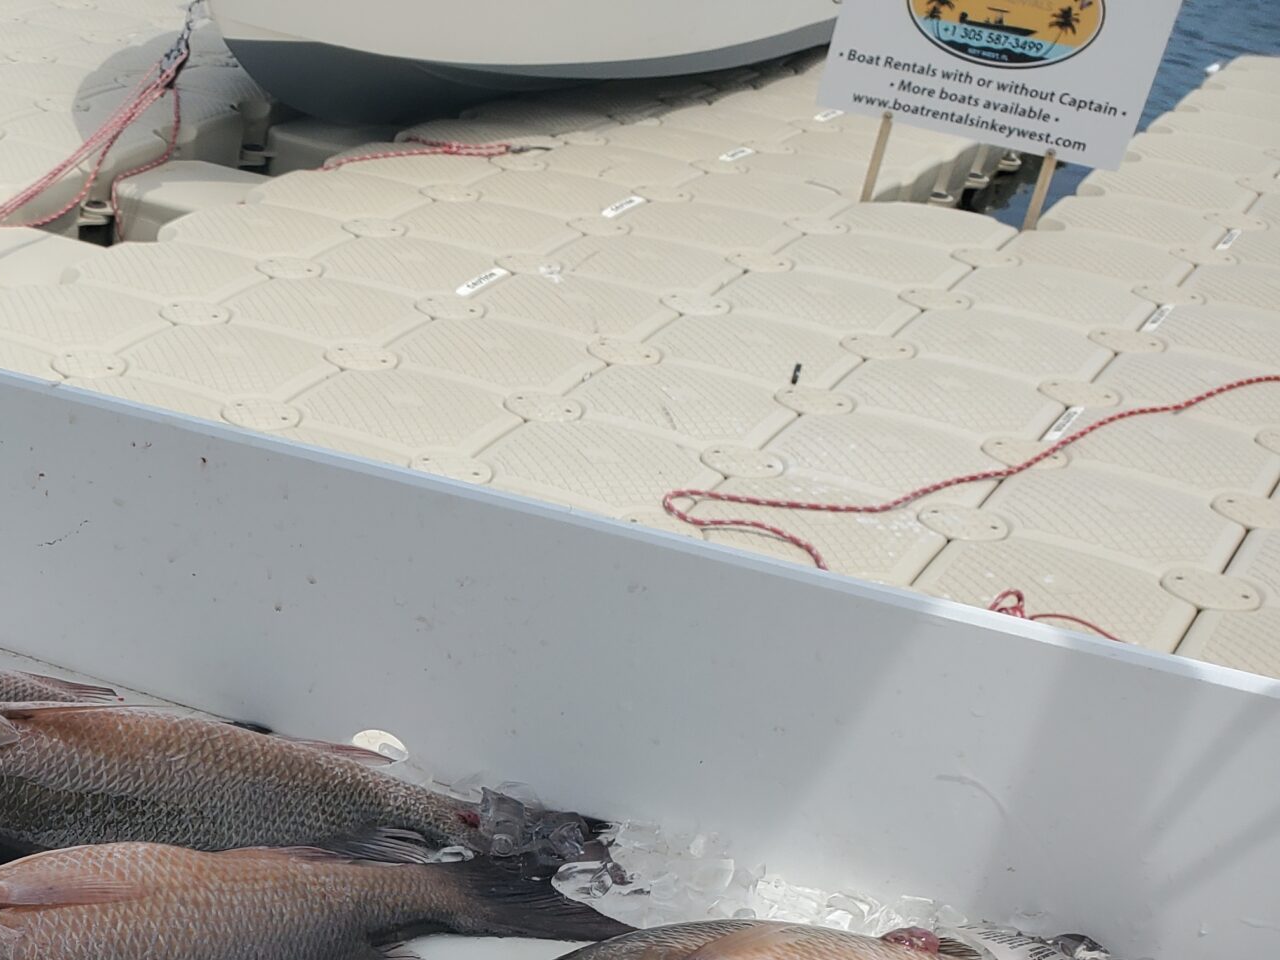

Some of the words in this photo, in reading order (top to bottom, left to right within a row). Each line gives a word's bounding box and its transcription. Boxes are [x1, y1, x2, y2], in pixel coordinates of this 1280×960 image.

[943, 25, 957, 37] +1
[960, 27, 983, 42] 305
[986, 32, 1044, 53] 587-3499
[847, 49, 881, 66] Boat
[883, 56, 938, 78] Rentals
[941, 69, 974, 86] with
[977, 77, 994, 88] or
[996, 81, 1056, 103] without
[1059, 92, 1118, 117] Captain
[898, 80, 936, 98] More
[939, 87, 980, 107] boats
[983, 99, 1051, 123] available
[852, 93, 1087, 152] www.boatrentalsinkeywest.com
